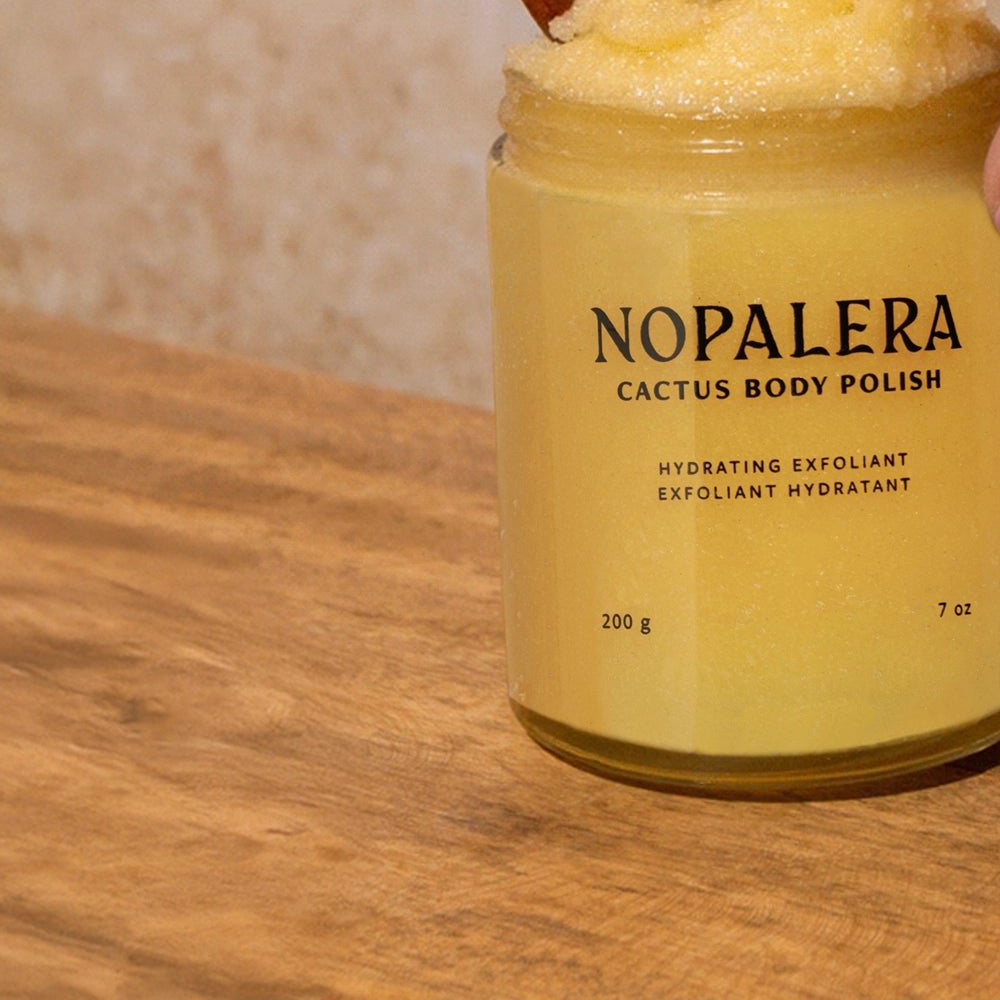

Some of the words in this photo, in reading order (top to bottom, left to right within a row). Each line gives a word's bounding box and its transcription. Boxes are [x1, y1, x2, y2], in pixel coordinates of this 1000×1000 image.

[589, 294, 963, 364] NOPALERA
[616, 379, 731, 402] CACTUS
[744, 376, 828, 399] BODY
[840, 368, 942, 395] POLISH
[658, 458, 782, 476] HYDRATING
[792, 452, 909, 473] EXFOLIANT
[658, 484, 777, 501] EXFOLIANT
[787, 476, 911, 498] HYDRATANT
[937, 602, 948, 618] 7
[953, 602, 972, 617] oz
[601, 613, 633, 630] 200
[639, 616, 652, 636] g
